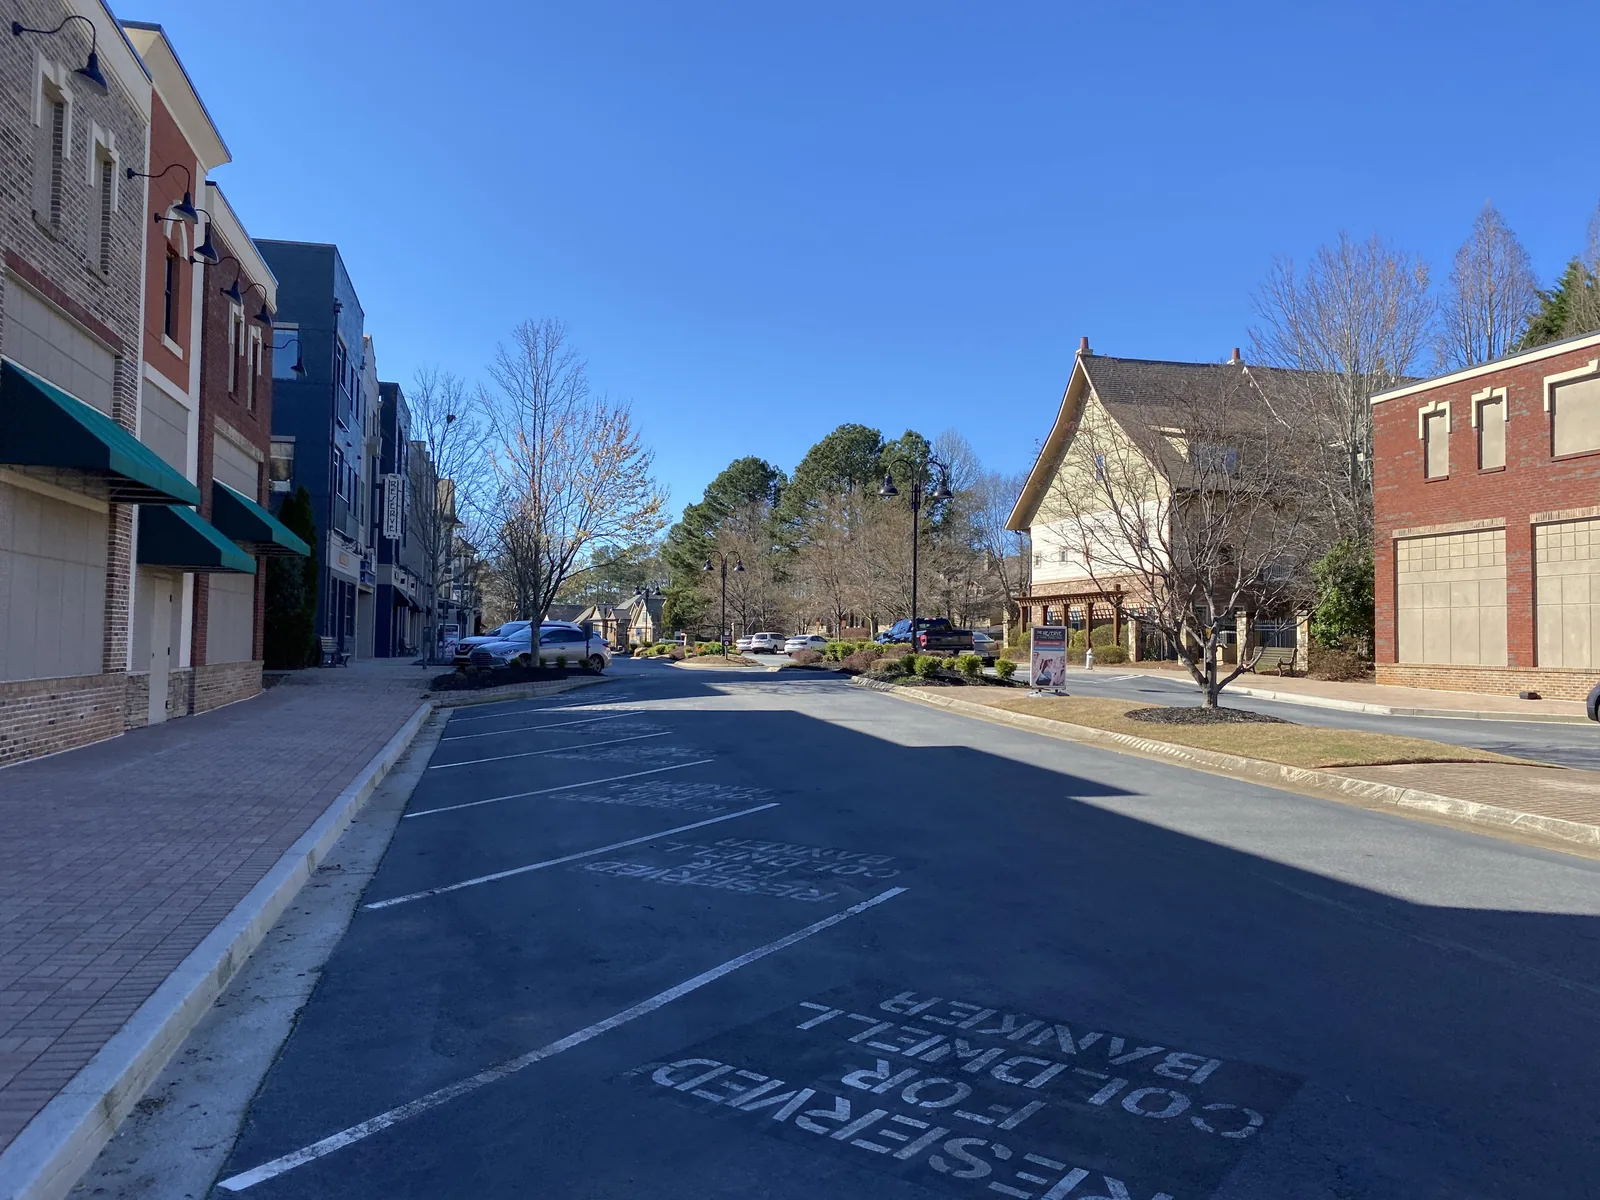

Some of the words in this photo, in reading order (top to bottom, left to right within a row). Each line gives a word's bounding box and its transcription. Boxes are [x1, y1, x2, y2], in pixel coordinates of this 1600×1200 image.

[389, 480, 397, 532] RESERVE
[796, 1000, 1264, 1139] COLDWELL
[879, 990, 1223, 1084] BANKER
[840, 1058, 1047, 1131] FOR
